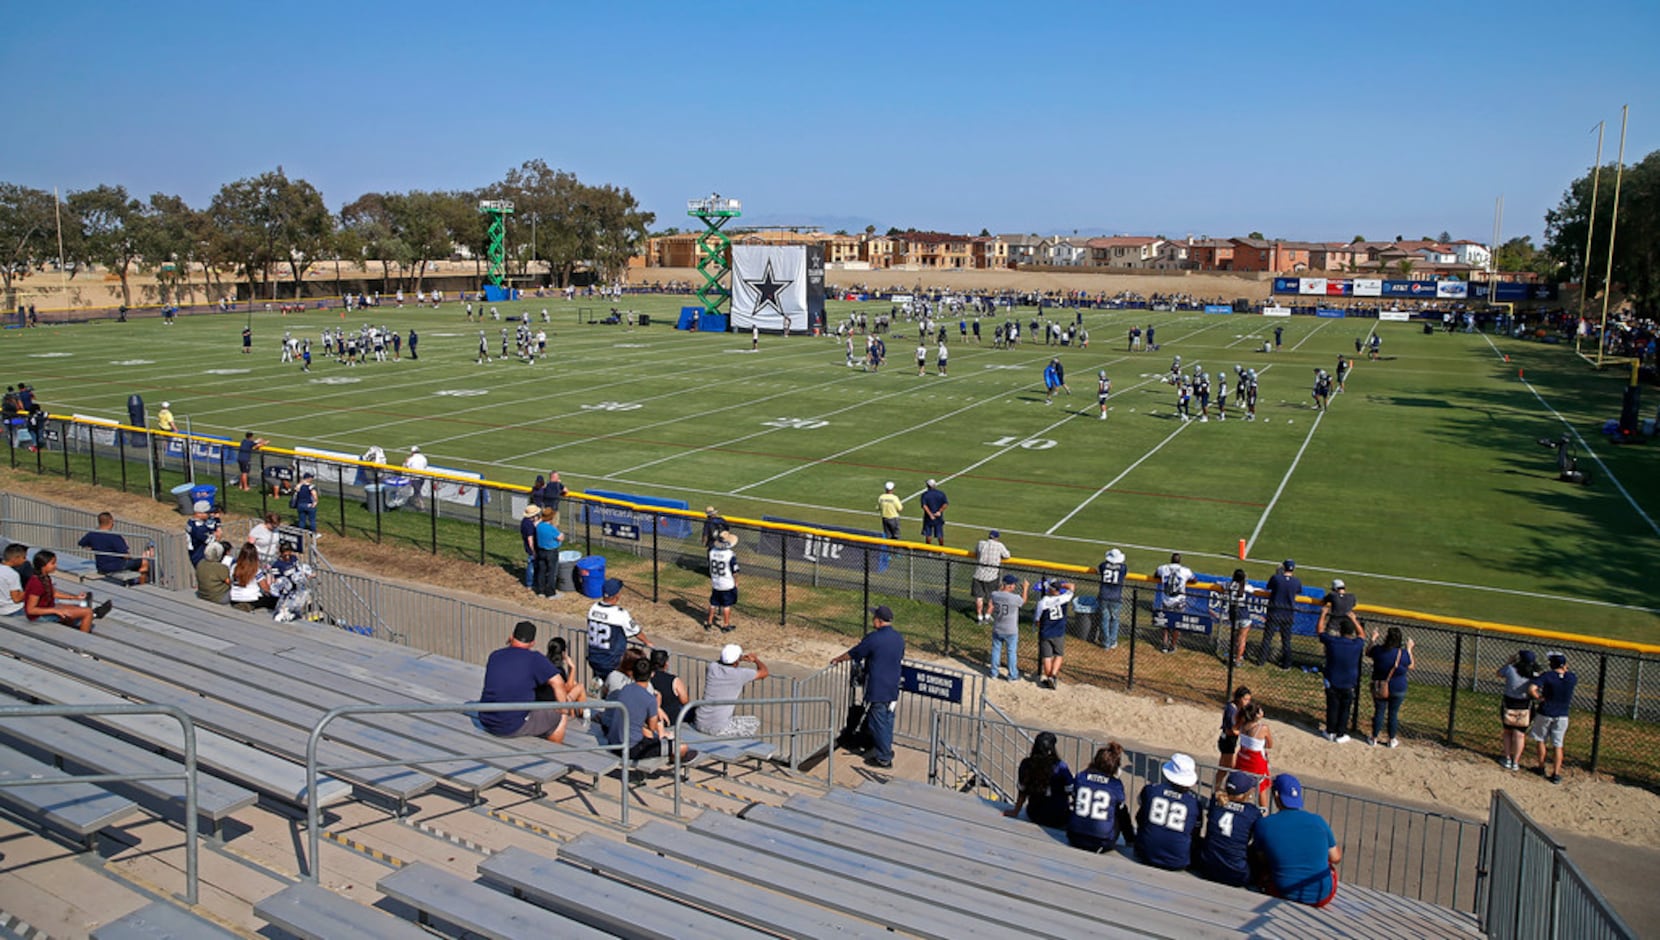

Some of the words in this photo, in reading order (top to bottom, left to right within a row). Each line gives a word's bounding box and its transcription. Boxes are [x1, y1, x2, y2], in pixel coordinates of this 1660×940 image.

[983, 436, 1059, 450] 10
[711, 559, 727, 577] 82
[1102, 569, 1120, 585] 21
[1049, 605, 1064, 621] 21
[589, 620, 611, 650] 82
[916, 672, 926, 682] NO
[926, 675, 953, 689] SMOKING
[1075, 786, 1111, 821] 82
[1149, 796, 1188, 833] 82
[1218, 811, 1235, 838] 4
